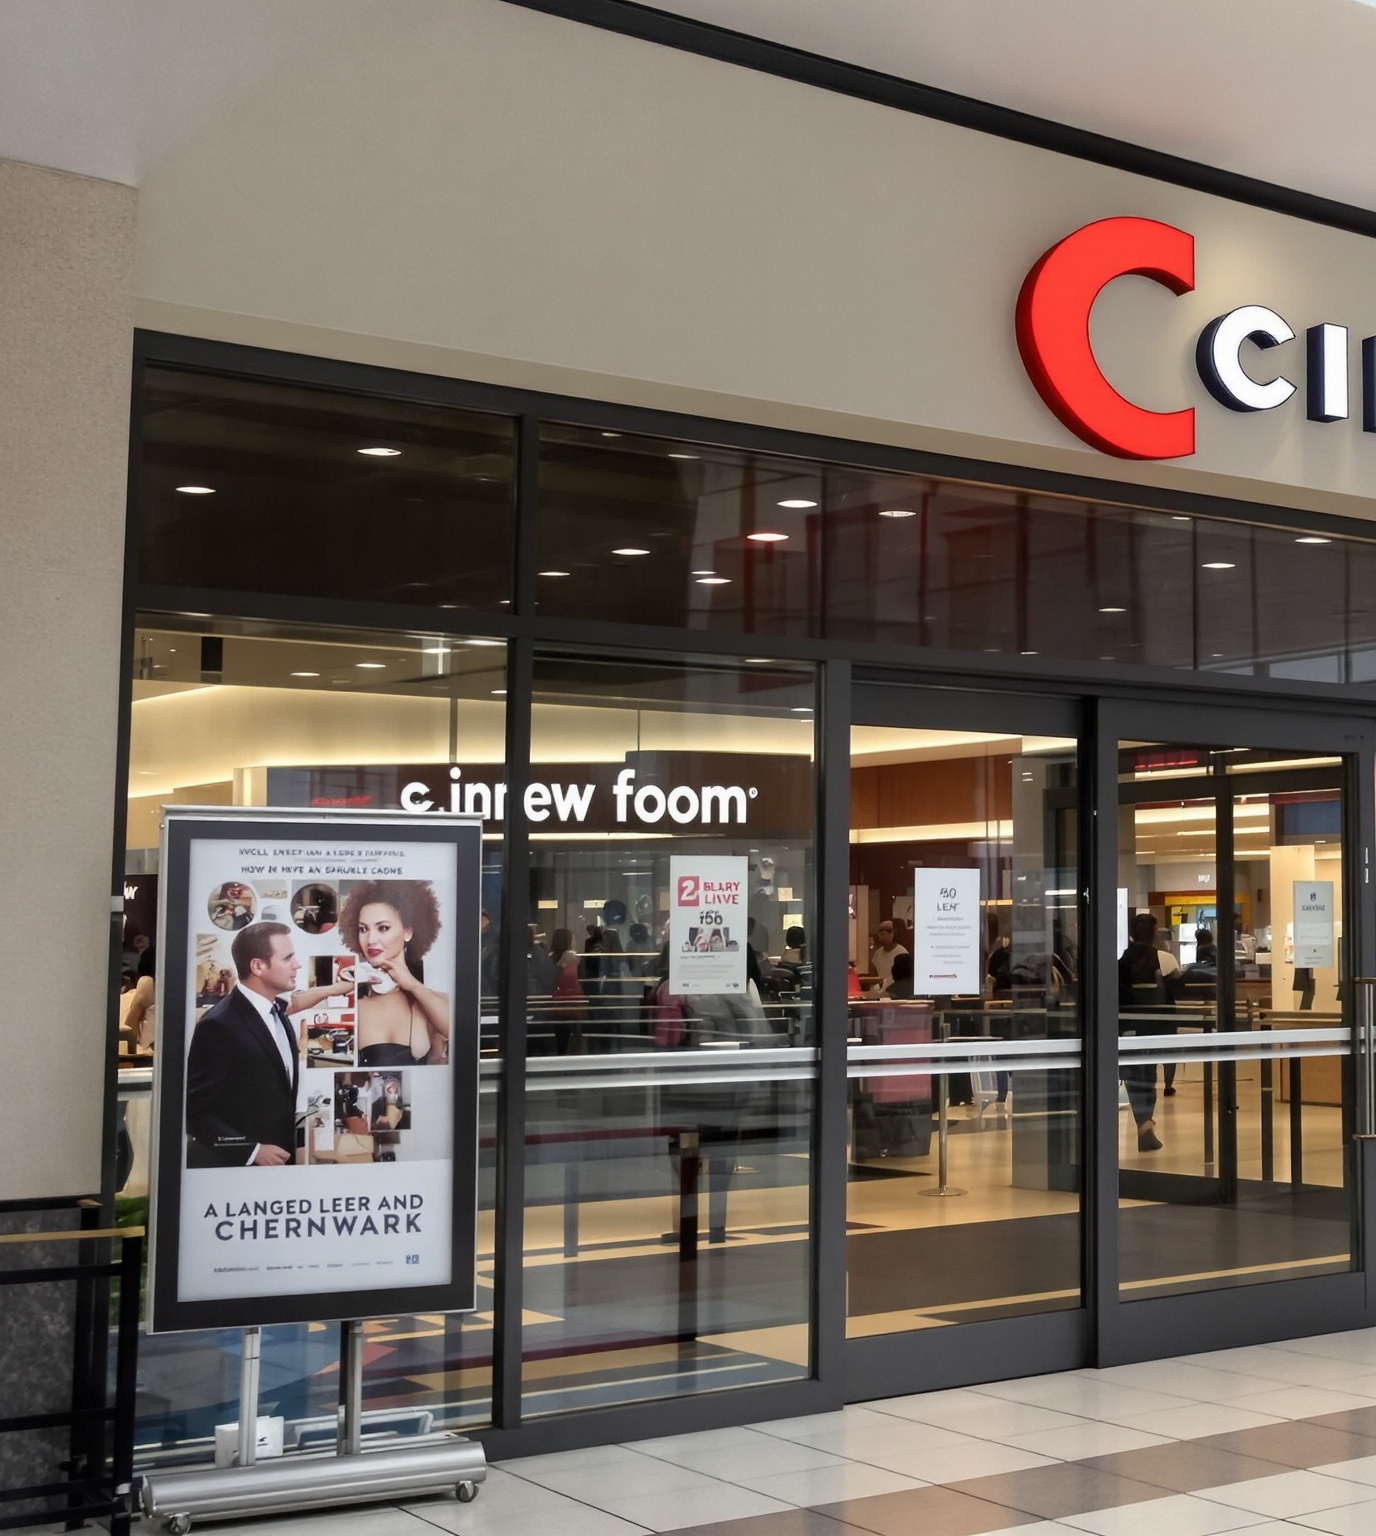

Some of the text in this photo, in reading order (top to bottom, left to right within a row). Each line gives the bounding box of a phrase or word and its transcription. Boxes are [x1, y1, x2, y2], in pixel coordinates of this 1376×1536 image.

[203, 1194, 424, 1219] A LANGED LEER AND
[214, 1212, 423, 1242] CHERNWARK
